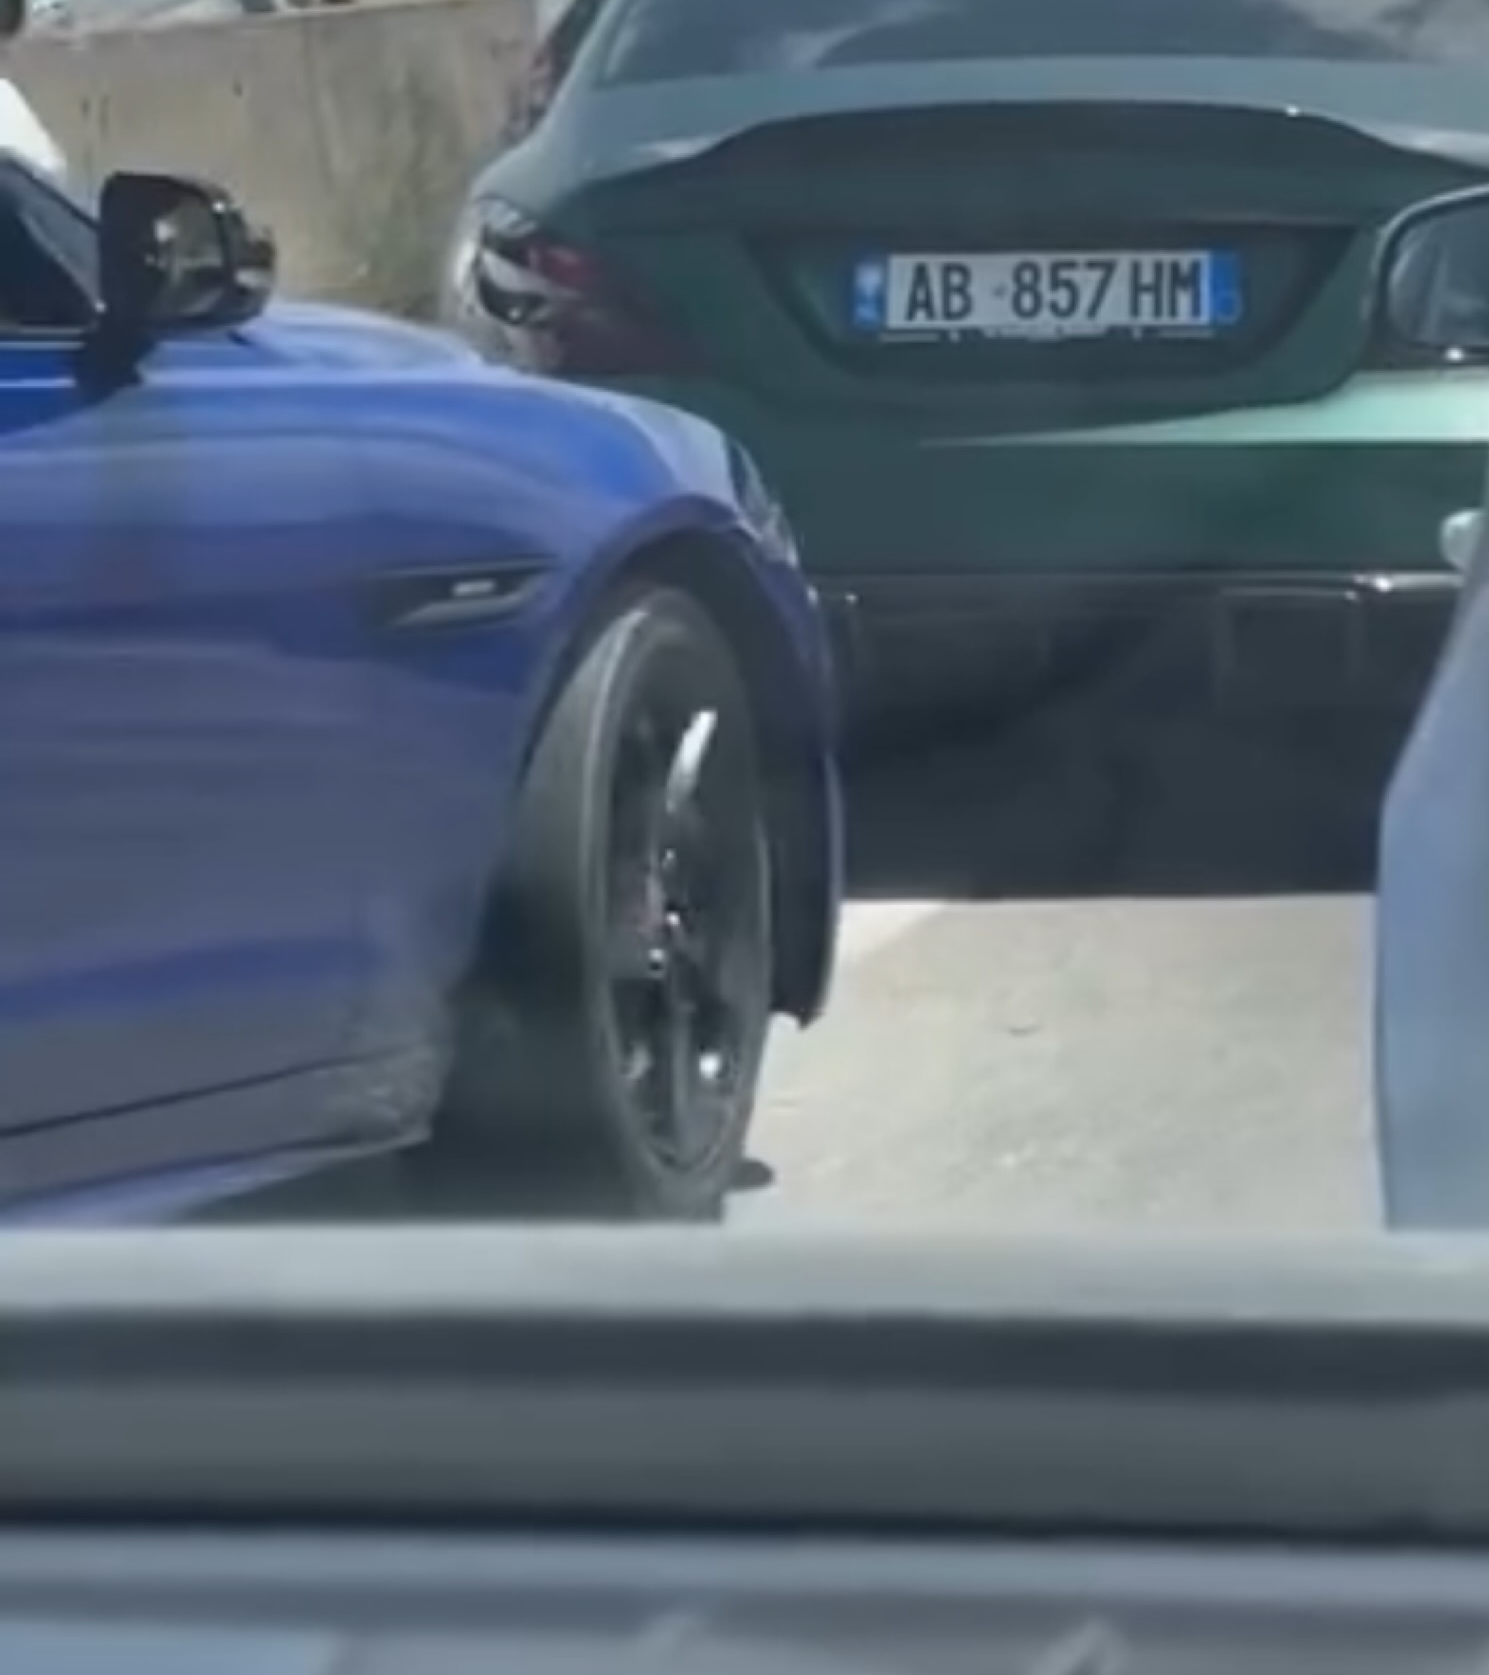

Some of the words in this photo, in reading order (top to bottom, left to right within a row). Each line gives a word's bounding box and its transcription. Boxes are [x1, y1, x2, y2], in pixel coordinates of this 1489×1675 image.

[905, 261, 974, 322] AB
[1010, 258, 1118, 321] 857
[1128, 257, 1202, 320] HM
